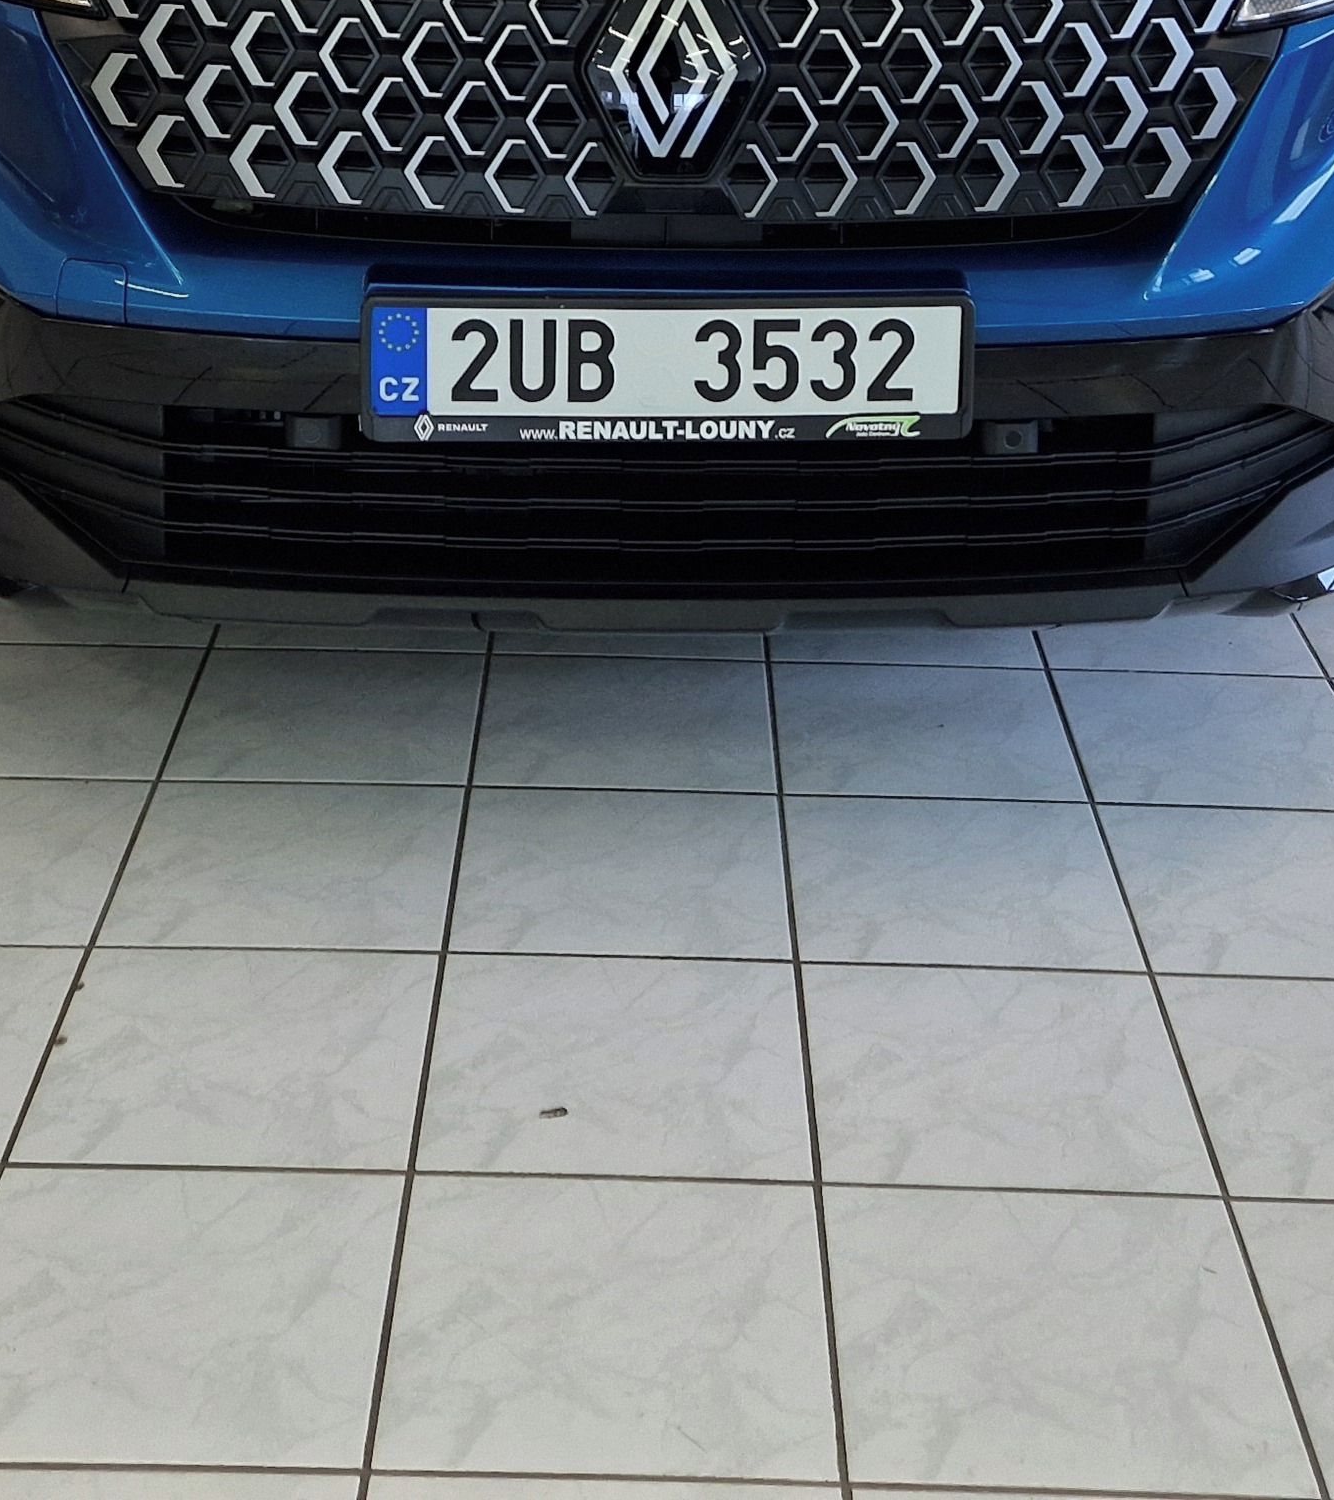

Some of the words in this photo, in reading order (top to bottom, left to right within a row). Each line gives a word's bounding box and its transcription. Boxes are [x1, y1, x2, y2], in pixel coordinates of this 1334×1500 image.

[451, 319, 615, 402] 2UB
[694, 318, 915, 402] 3532
[379, 377, 420, 402] CZ
[437, 423, 489, 432] RENAULT
